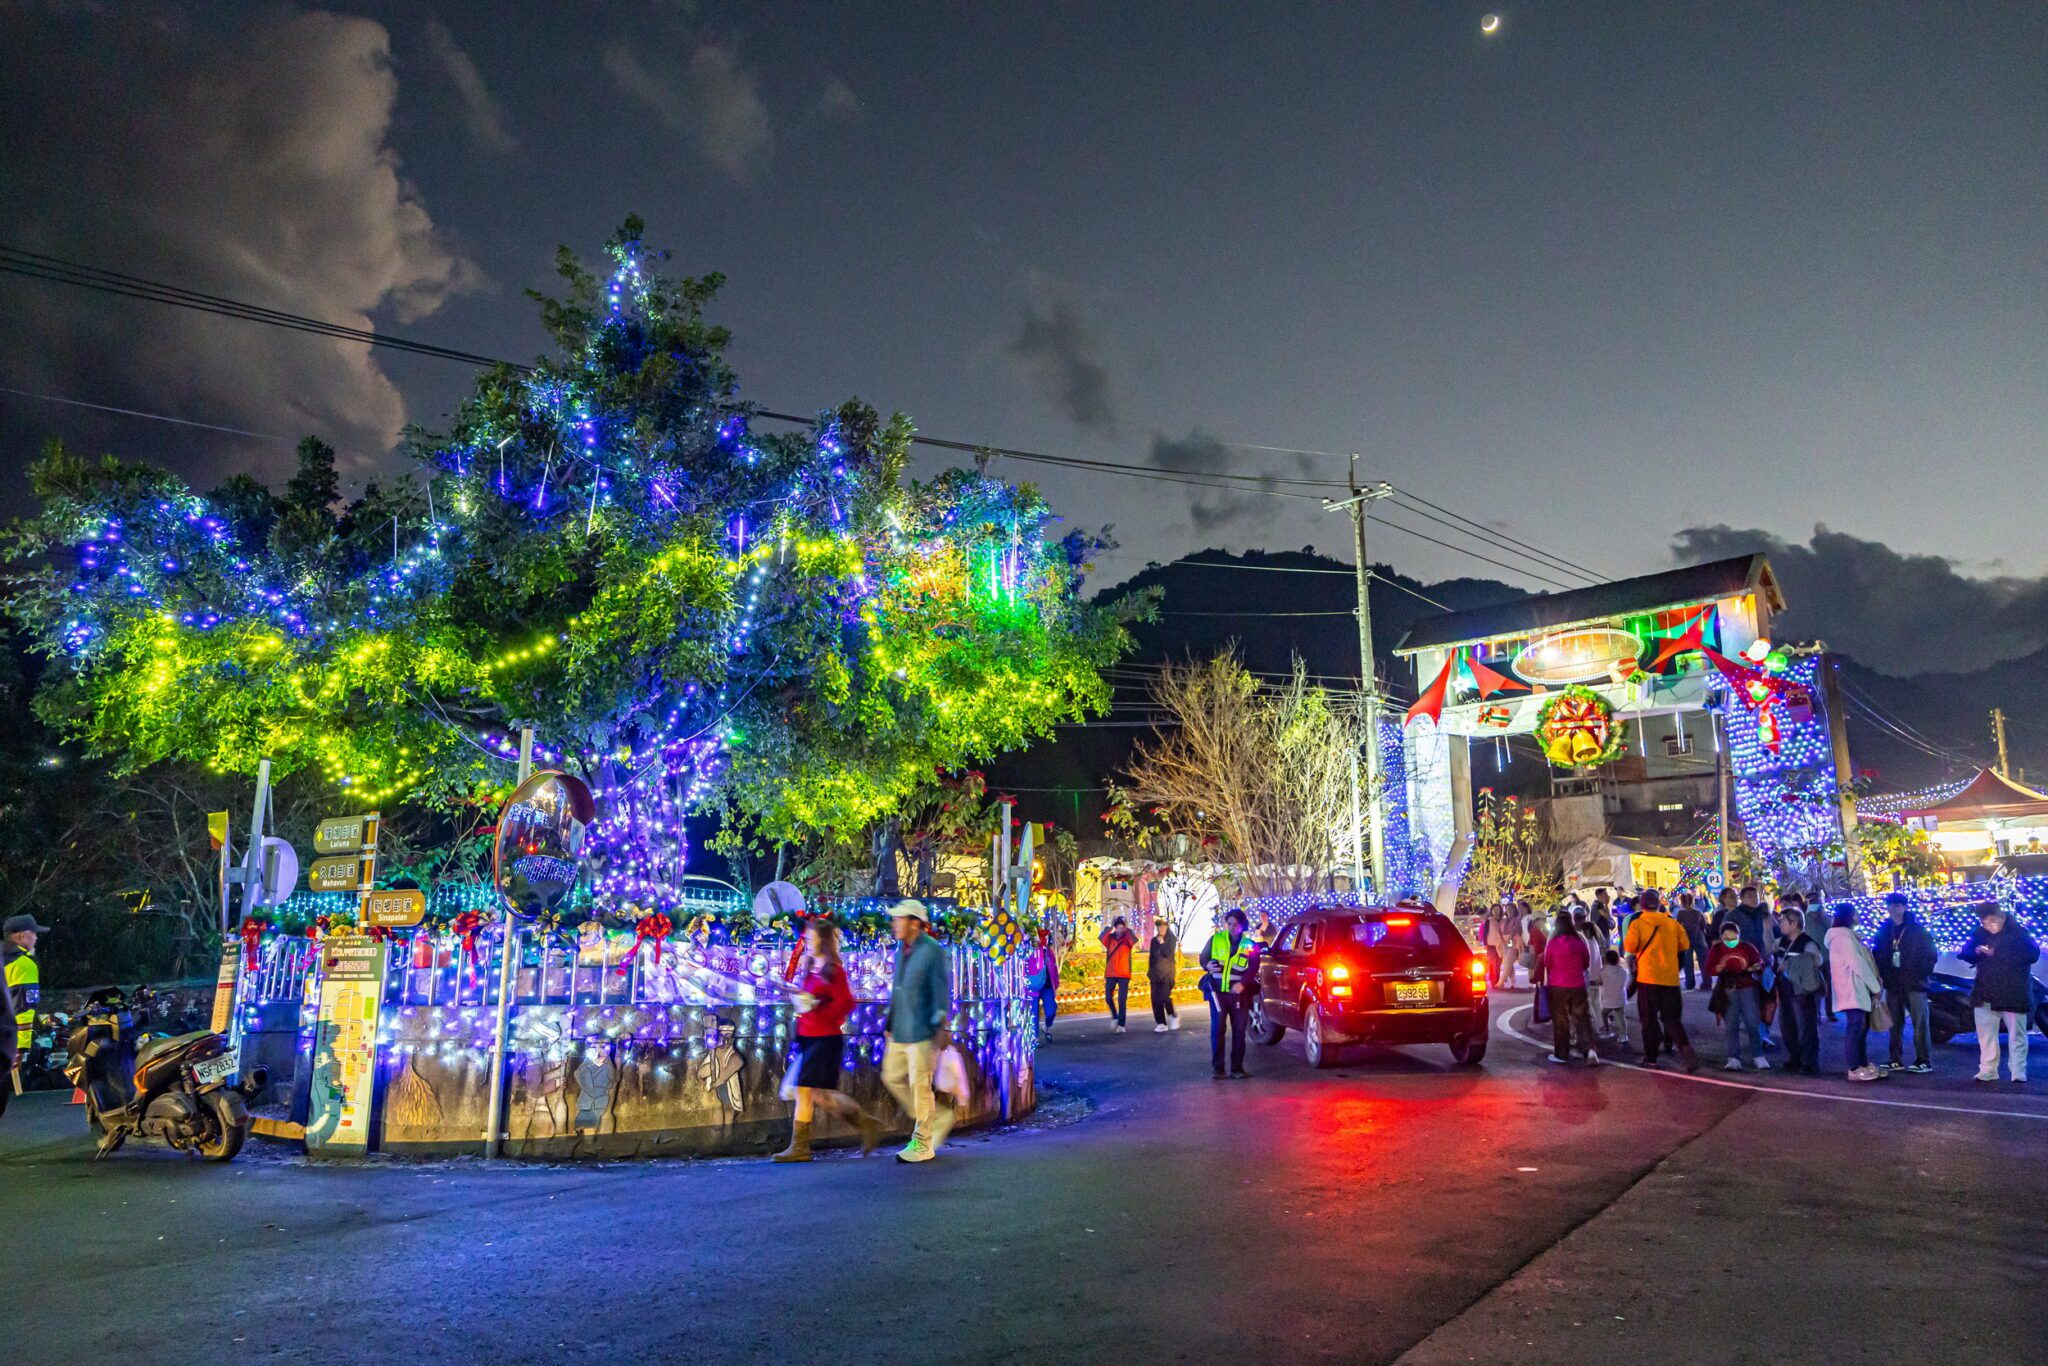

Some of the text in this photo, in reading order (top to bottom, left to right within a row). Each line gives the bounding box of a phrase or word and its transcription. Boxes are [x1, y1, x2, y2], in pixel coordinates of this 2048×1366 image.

[320, 864, 355, 879] 久美部落
[1709, 875, 1720, 883] P1
[373, 898, 412, 913] 新鄉部落
[1397, 988, 1418, 999] 2992
